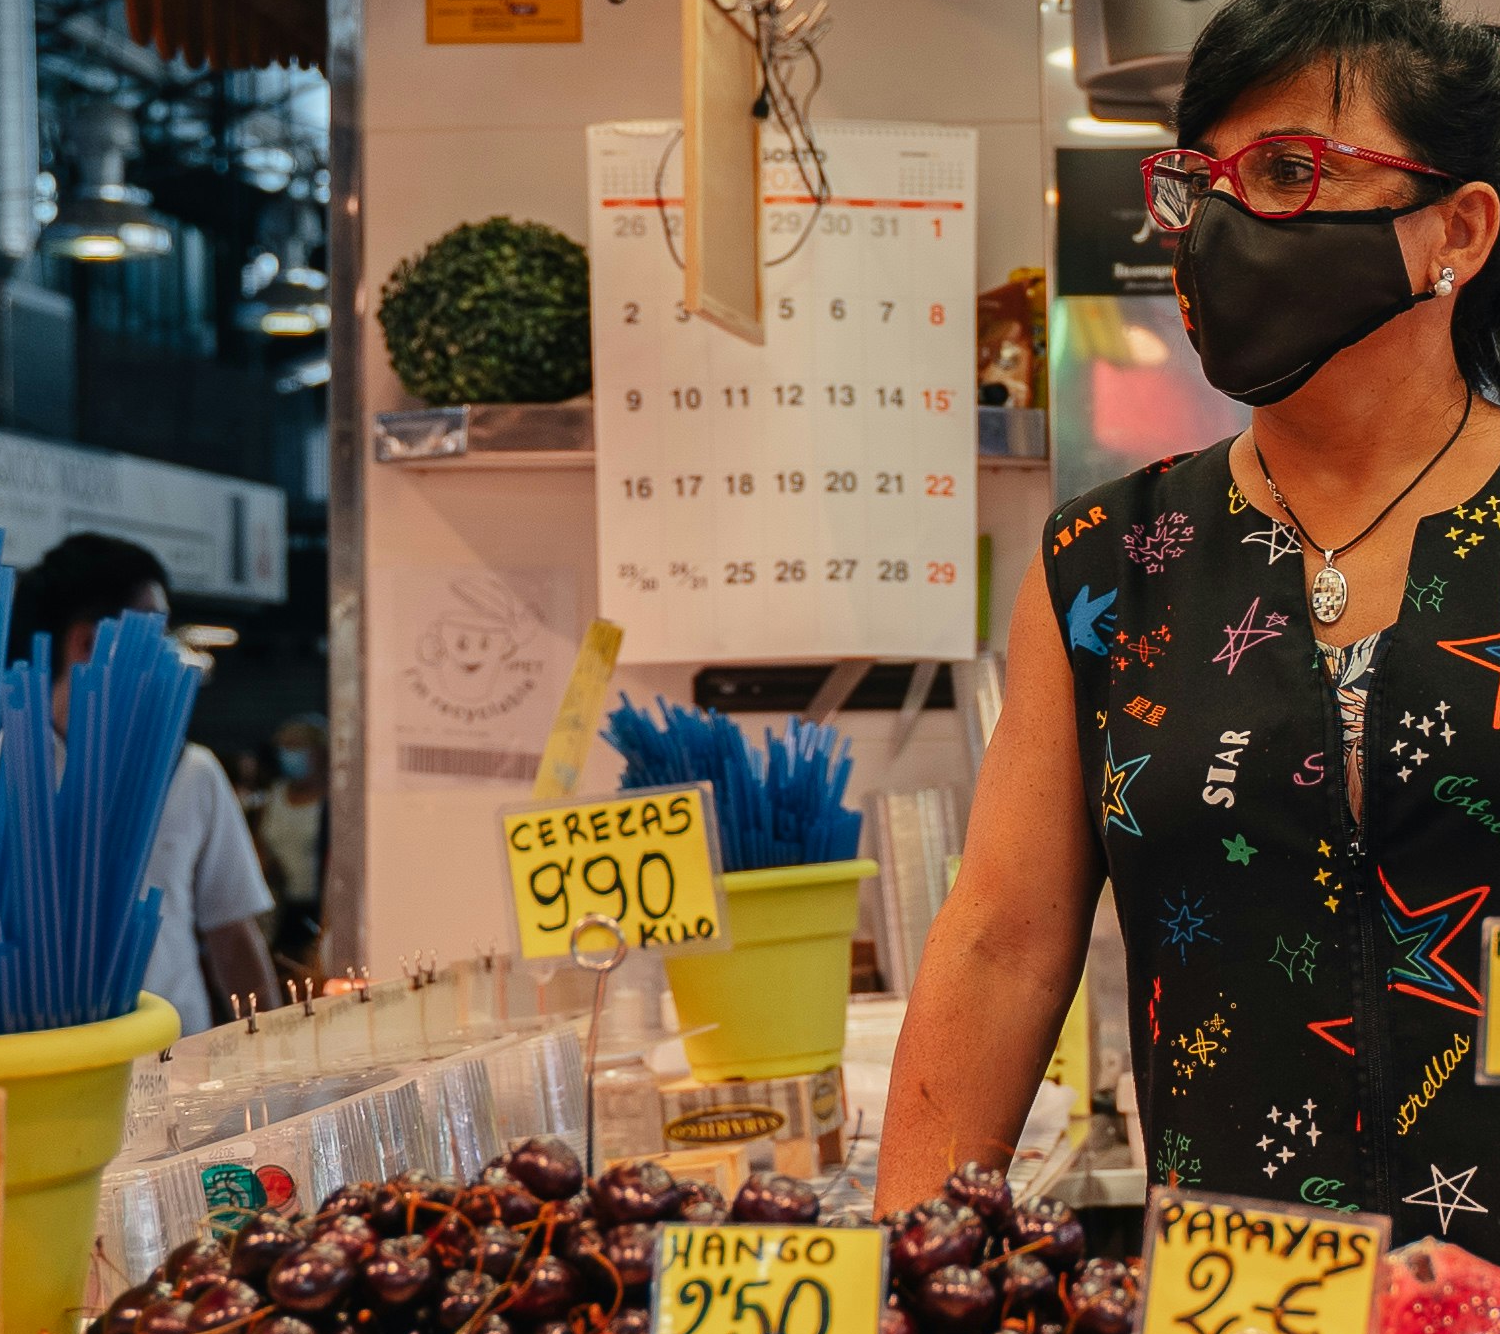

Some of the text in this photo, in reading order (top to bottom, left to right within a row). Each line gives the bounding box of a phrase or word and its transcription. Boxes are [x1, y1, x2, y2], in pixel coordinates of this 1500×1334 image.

[613, 215, 647, 238] 26
[769, 212, 799, 235] 29
[820, 213, 853, 236] 30
[871, 214, 899, 238] 31
[931, 218, 943, 239] 1
[624, 302, 640, 325] 2
[778, 297, 795, 320] 5
[829, 298, 846, 321] 6
[879, 300, 896, 323] 7
[928, 303, 946, 326] 8
[625, 389, 642, 412] 9
[670, 387, 702, 411] 10
[724, 385, 751, 407] 11
[773, 384, 805, 407] 12
[824, 384, 856, 407] 13
[875, 385, 905, 408] 14
[622, 471, 956, 499] 16 17 18 19 20 21 22
[1053, 505, 1107, 556] TAR
[724, 562, 757, 585] 25
[774, 560, 807, 583] 26
[825, 559, 859, 581] 27
[877, 560, 910, 583] 28
[926, 561, 957, 584] 29
[1202, 729, 1252, 809] STAR
[510, 796, 692, 851] CEREZAS
[529, 852, 676, 932] 9'90
[1161, 1202, 1372, 1278] PAPAYAS
